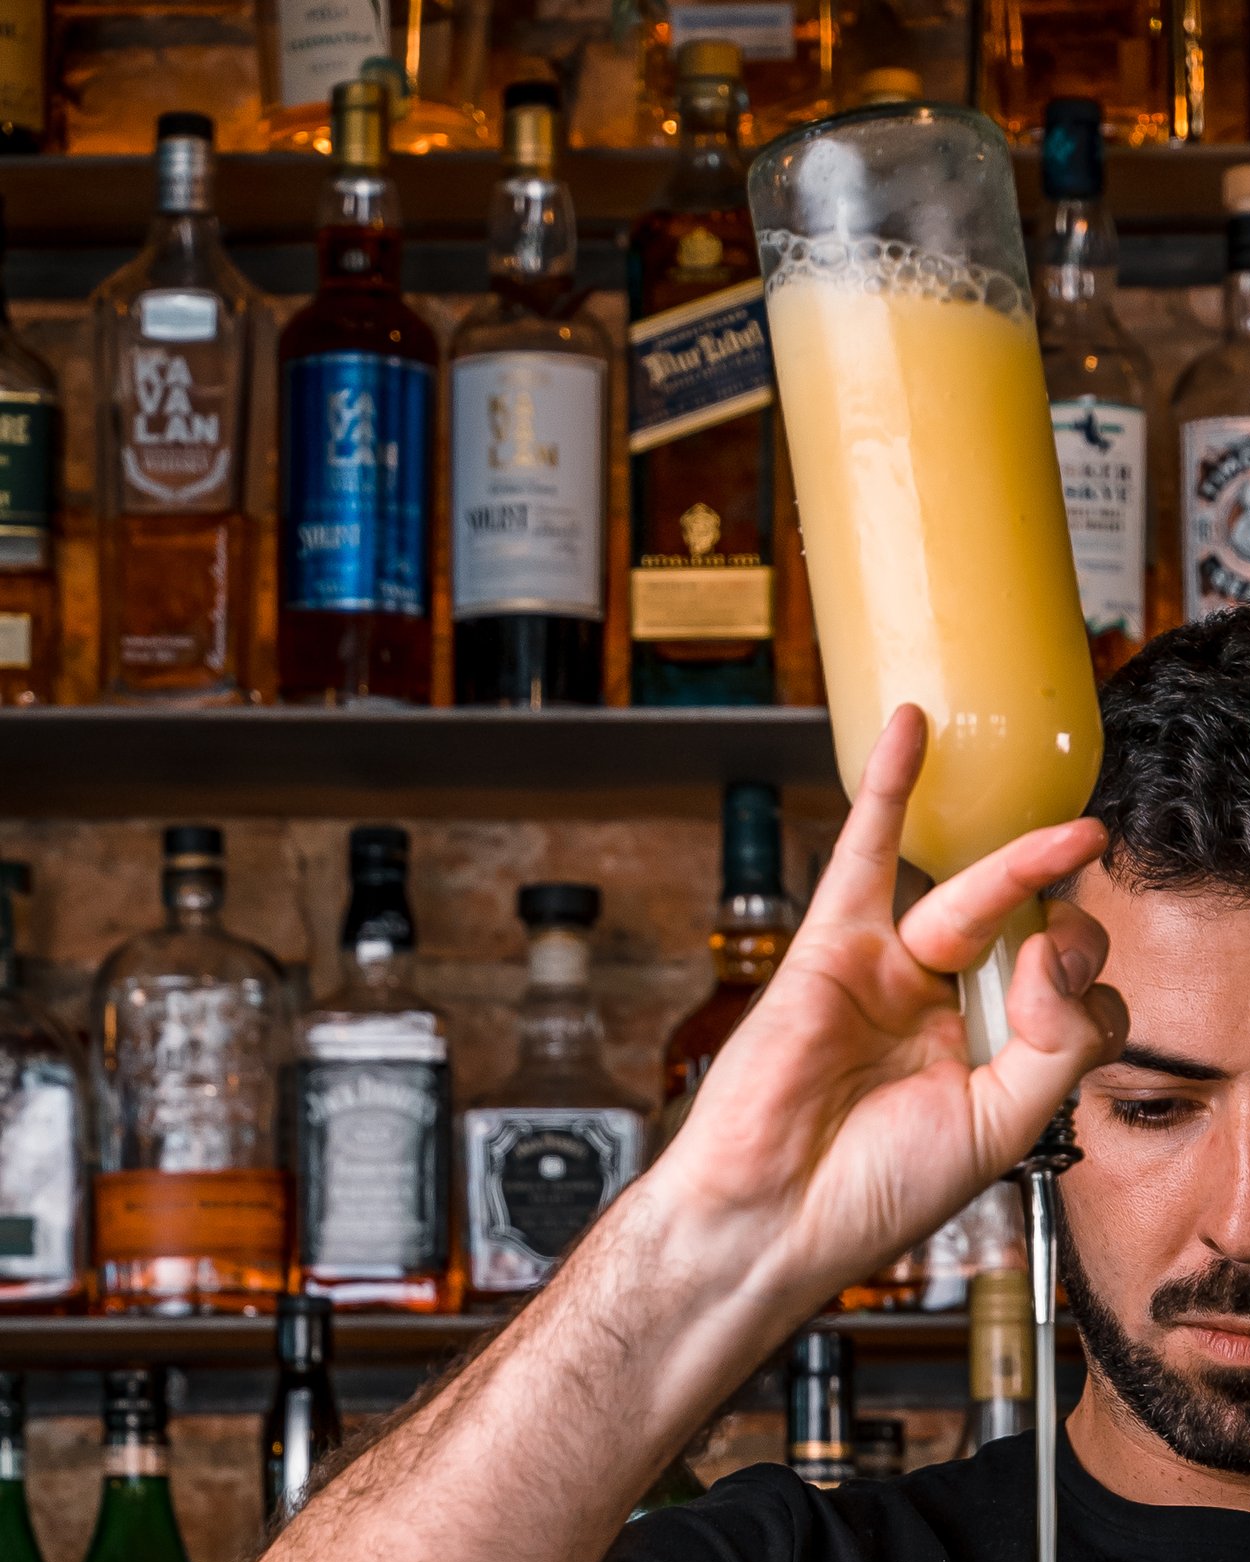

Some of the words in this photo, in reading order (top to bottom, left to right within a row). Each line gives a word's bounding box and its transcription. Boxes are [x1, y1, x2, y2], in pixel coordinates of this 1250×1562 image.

[133, 347, 192, 386] KA
[136, 384, 192, 415] VA
[133, 414, 219, 443] LAN
